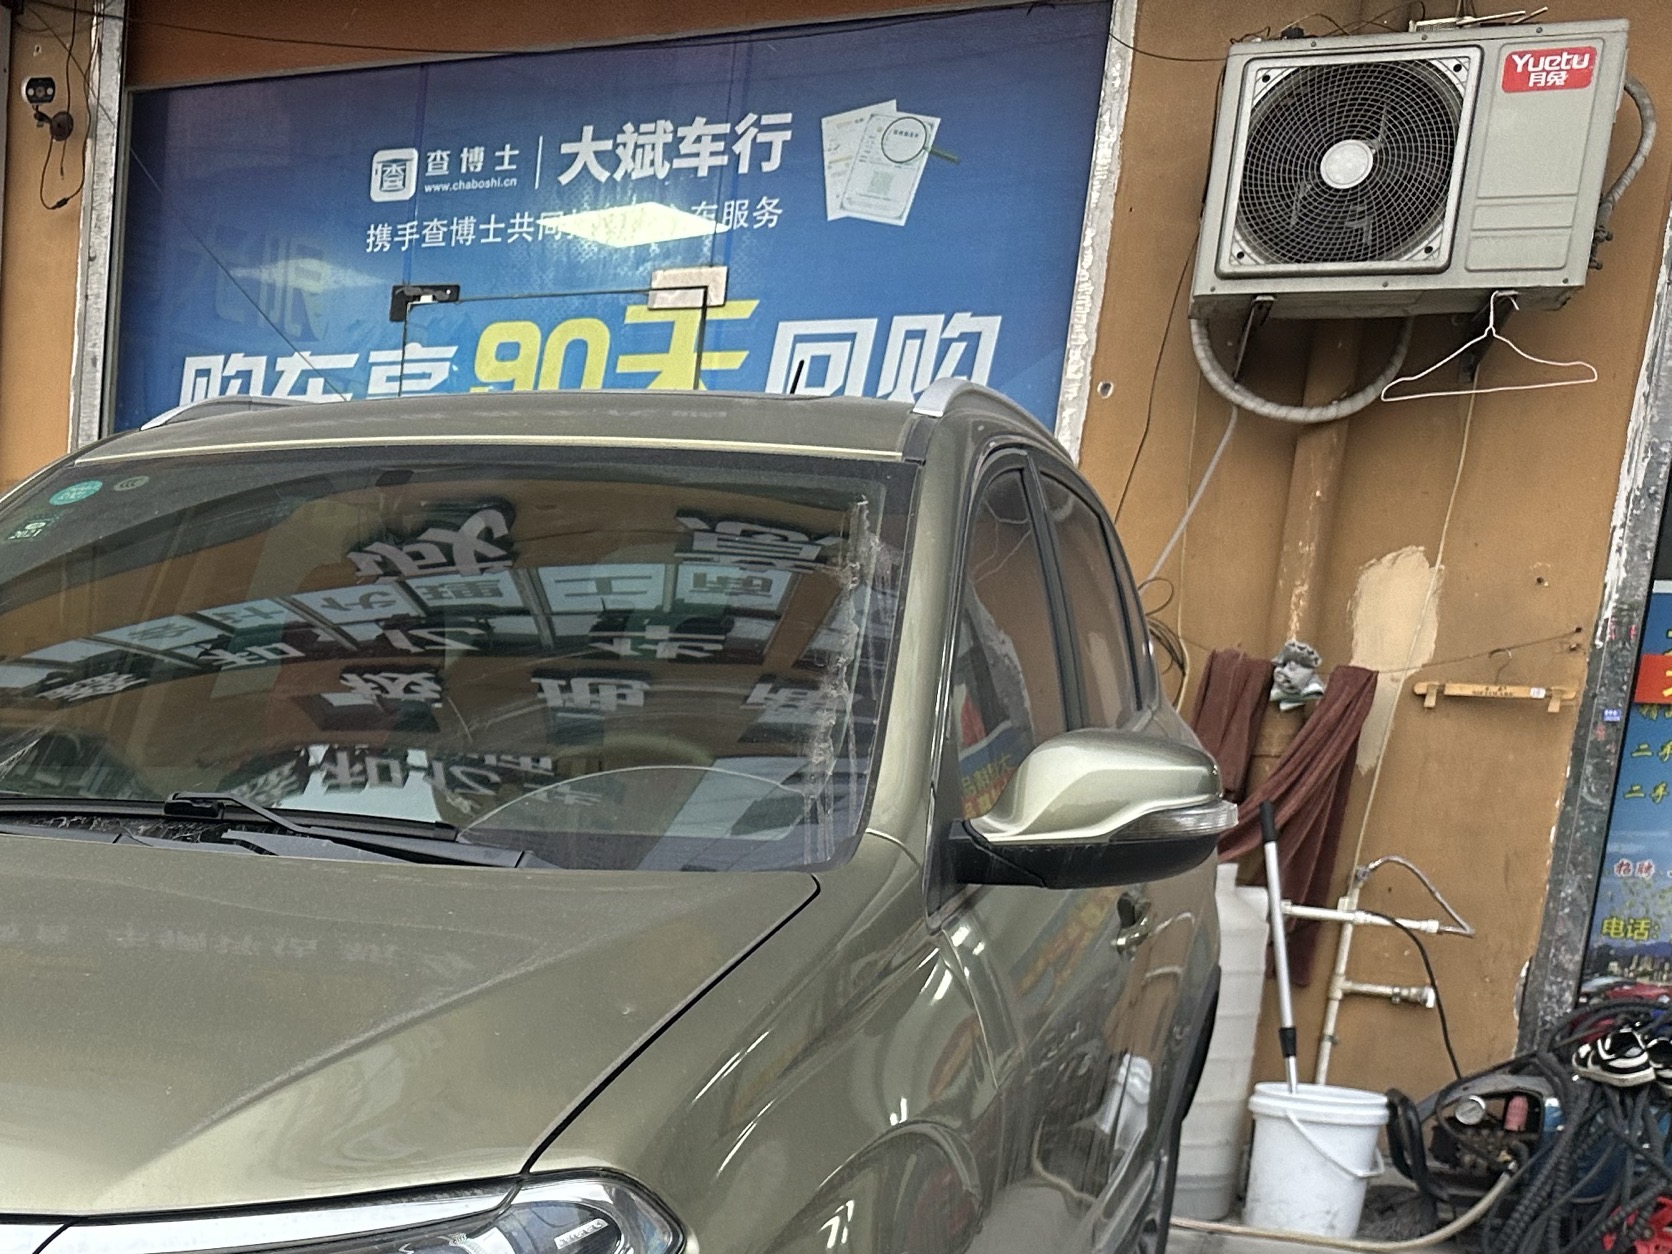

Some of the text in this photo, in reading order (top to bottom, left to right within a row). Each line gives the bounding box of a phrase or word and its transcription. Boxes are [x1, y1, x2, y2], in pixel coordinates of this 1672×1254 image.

[1511, 52, 1590, 73] Yuetu
[1528, 71, 1568, 87] 月兔
[425, 144, 520, 176] 查博士
[557, 113, 793, 186] 大斌车行
[424, 177, 518, 193] www.chaboshi.cn
